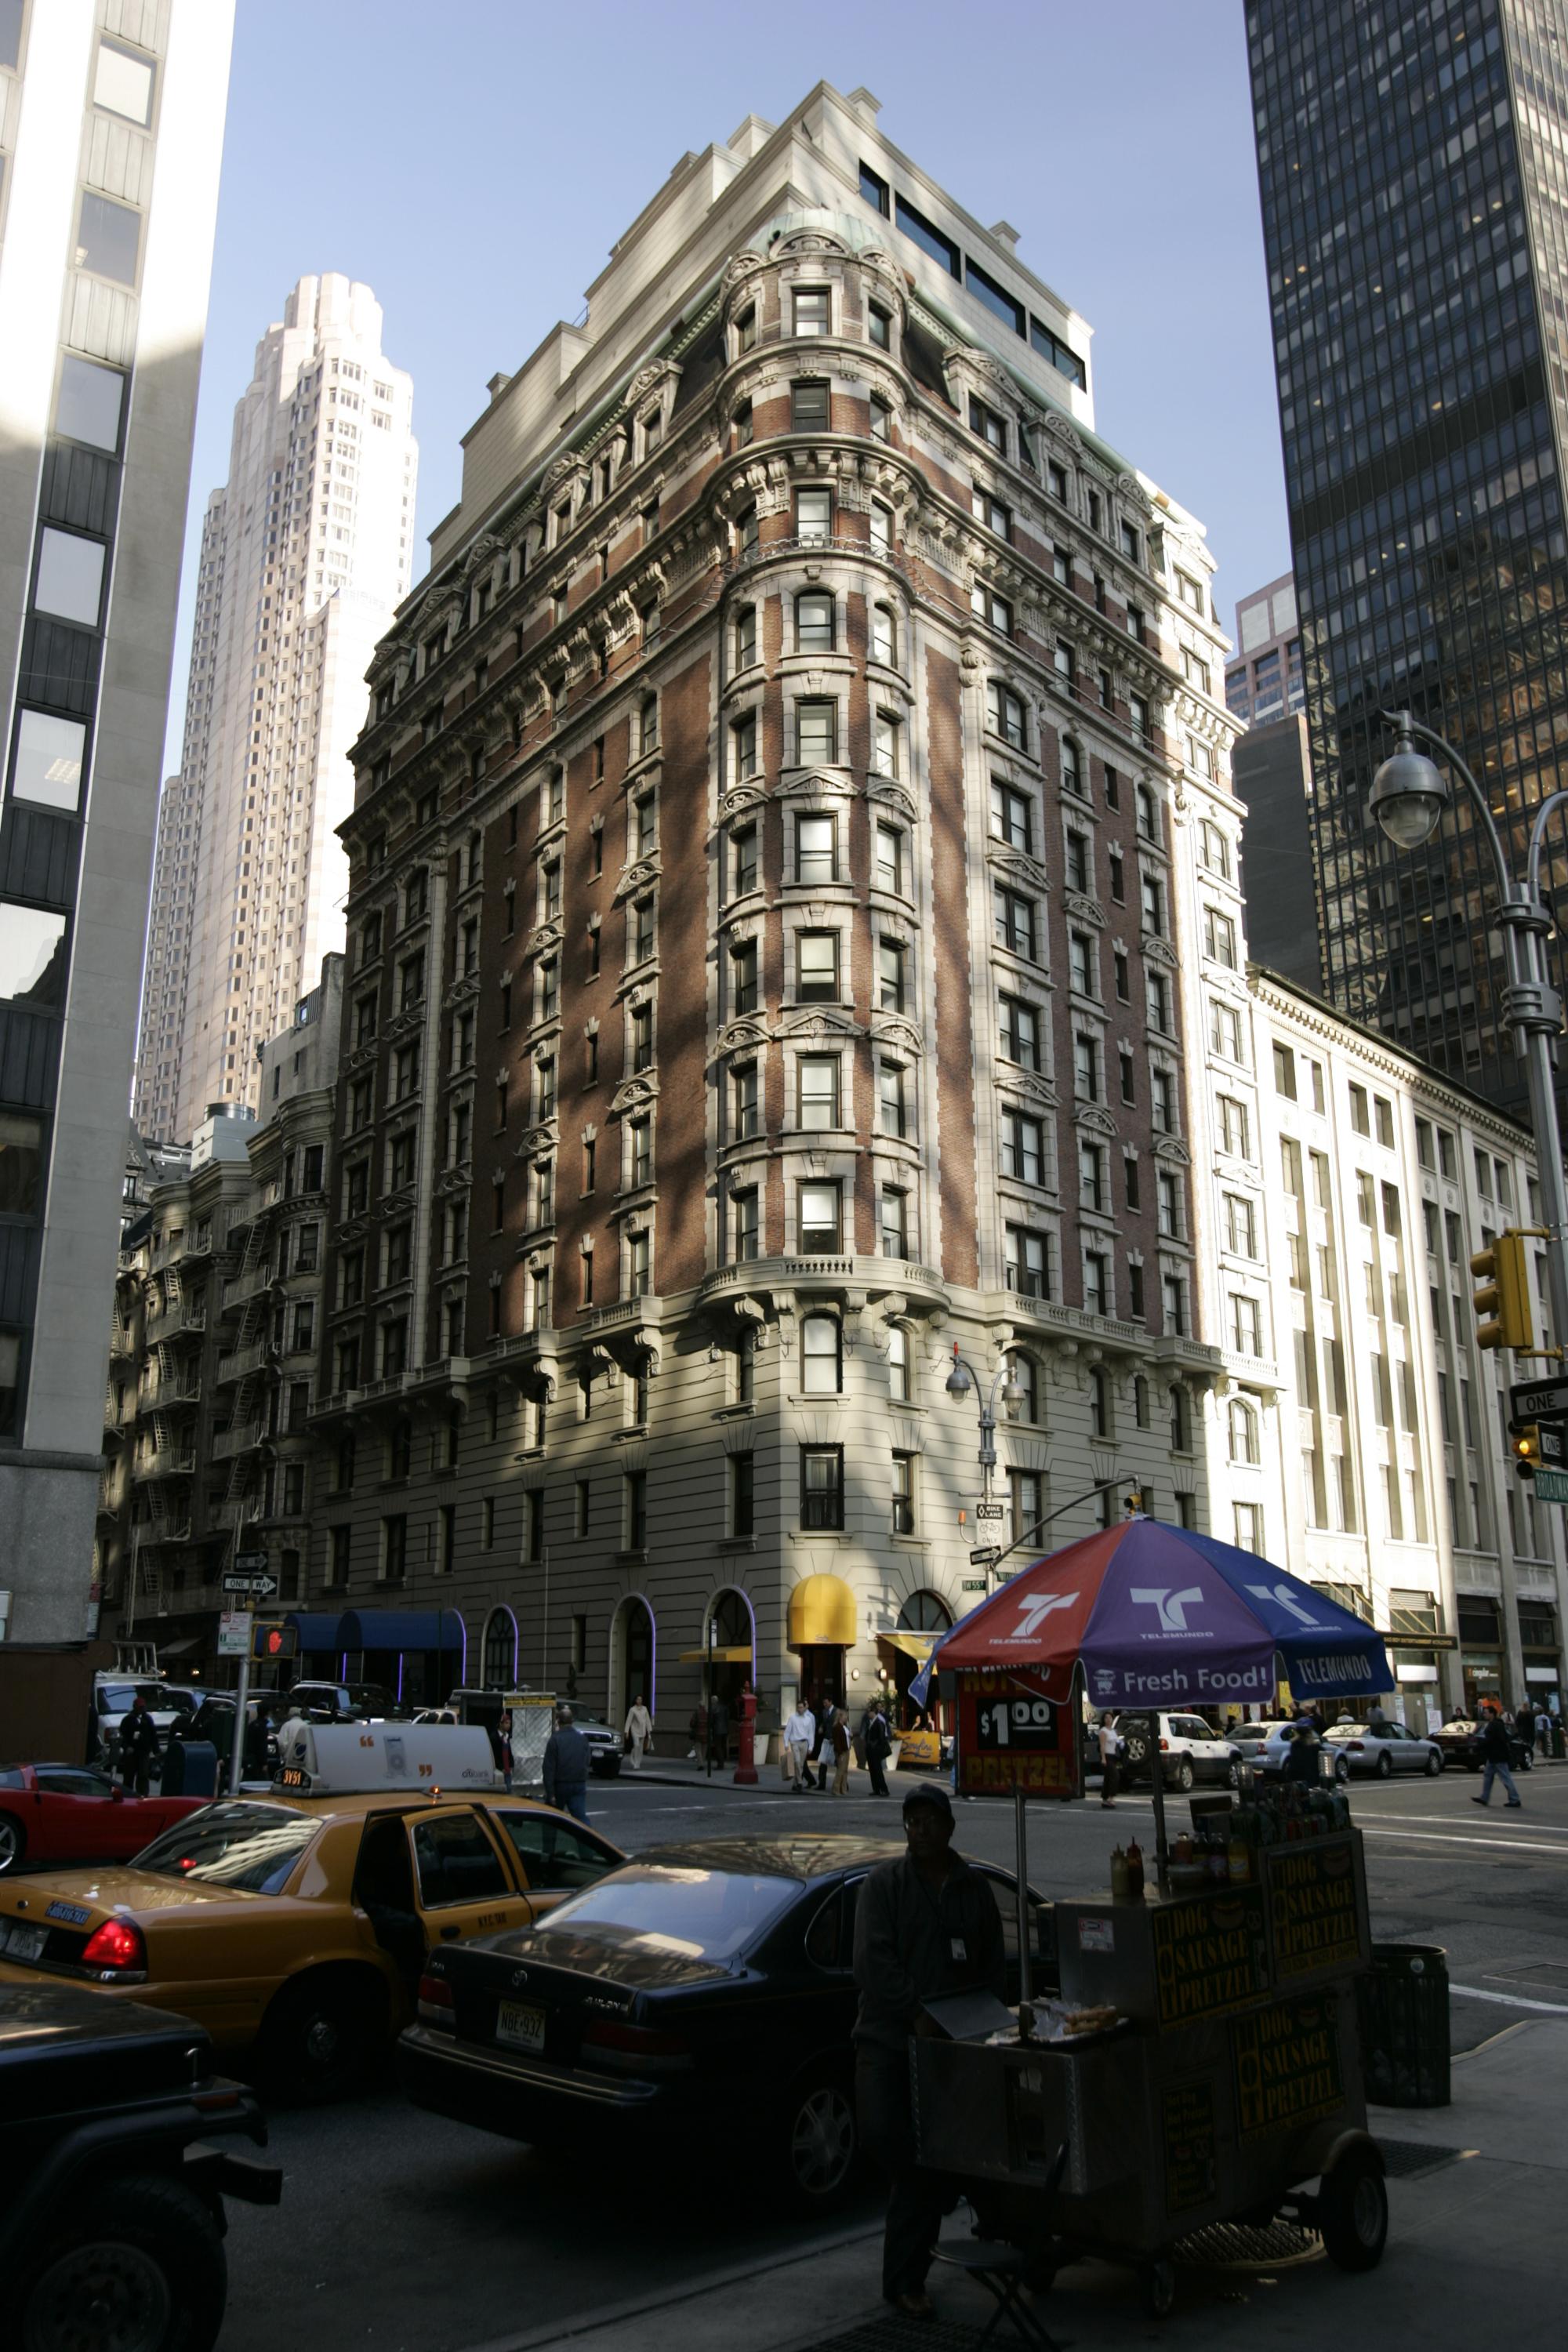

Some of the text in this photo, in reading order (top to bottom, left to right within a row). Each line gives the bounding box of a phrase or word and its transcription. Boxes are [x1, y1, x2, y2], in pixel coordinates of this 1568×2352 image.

[1526, 1392, 1555, 1411] ONE
[1546, 1436, 1560, 1454] ONE
[230, 1579, 245, 1588] ONE
[1139, 1631, 1214, 1640] TELEMUNDO
[1123, 1666, 1268, 1692] Fresh Food!
[1296, 1654, 1373, 1685] TELEMUNDO
[283, 1769, 302, 1785] 3Y51
[965, 1755, 1072, 1787] PRETZEL
[1287, 1853, 1318, 1886] DOG
[1288, 1878, 1355, 1919] SAUSAGE
[1173, 1903, 1208, 1939] DOG
[1291, 1910, 1356, 1953] PRETZEL
[1175, 1929, 1250, 1974] SAUSAGE
[1179, 1964, 1254, 2013] PRETZEL
[1260, 2007, 1293, 2042] DOG
[1262, 2029, 1330, 2080] SAUSAGE
[1266, 2069, 1337, 2121] PRETZEL
